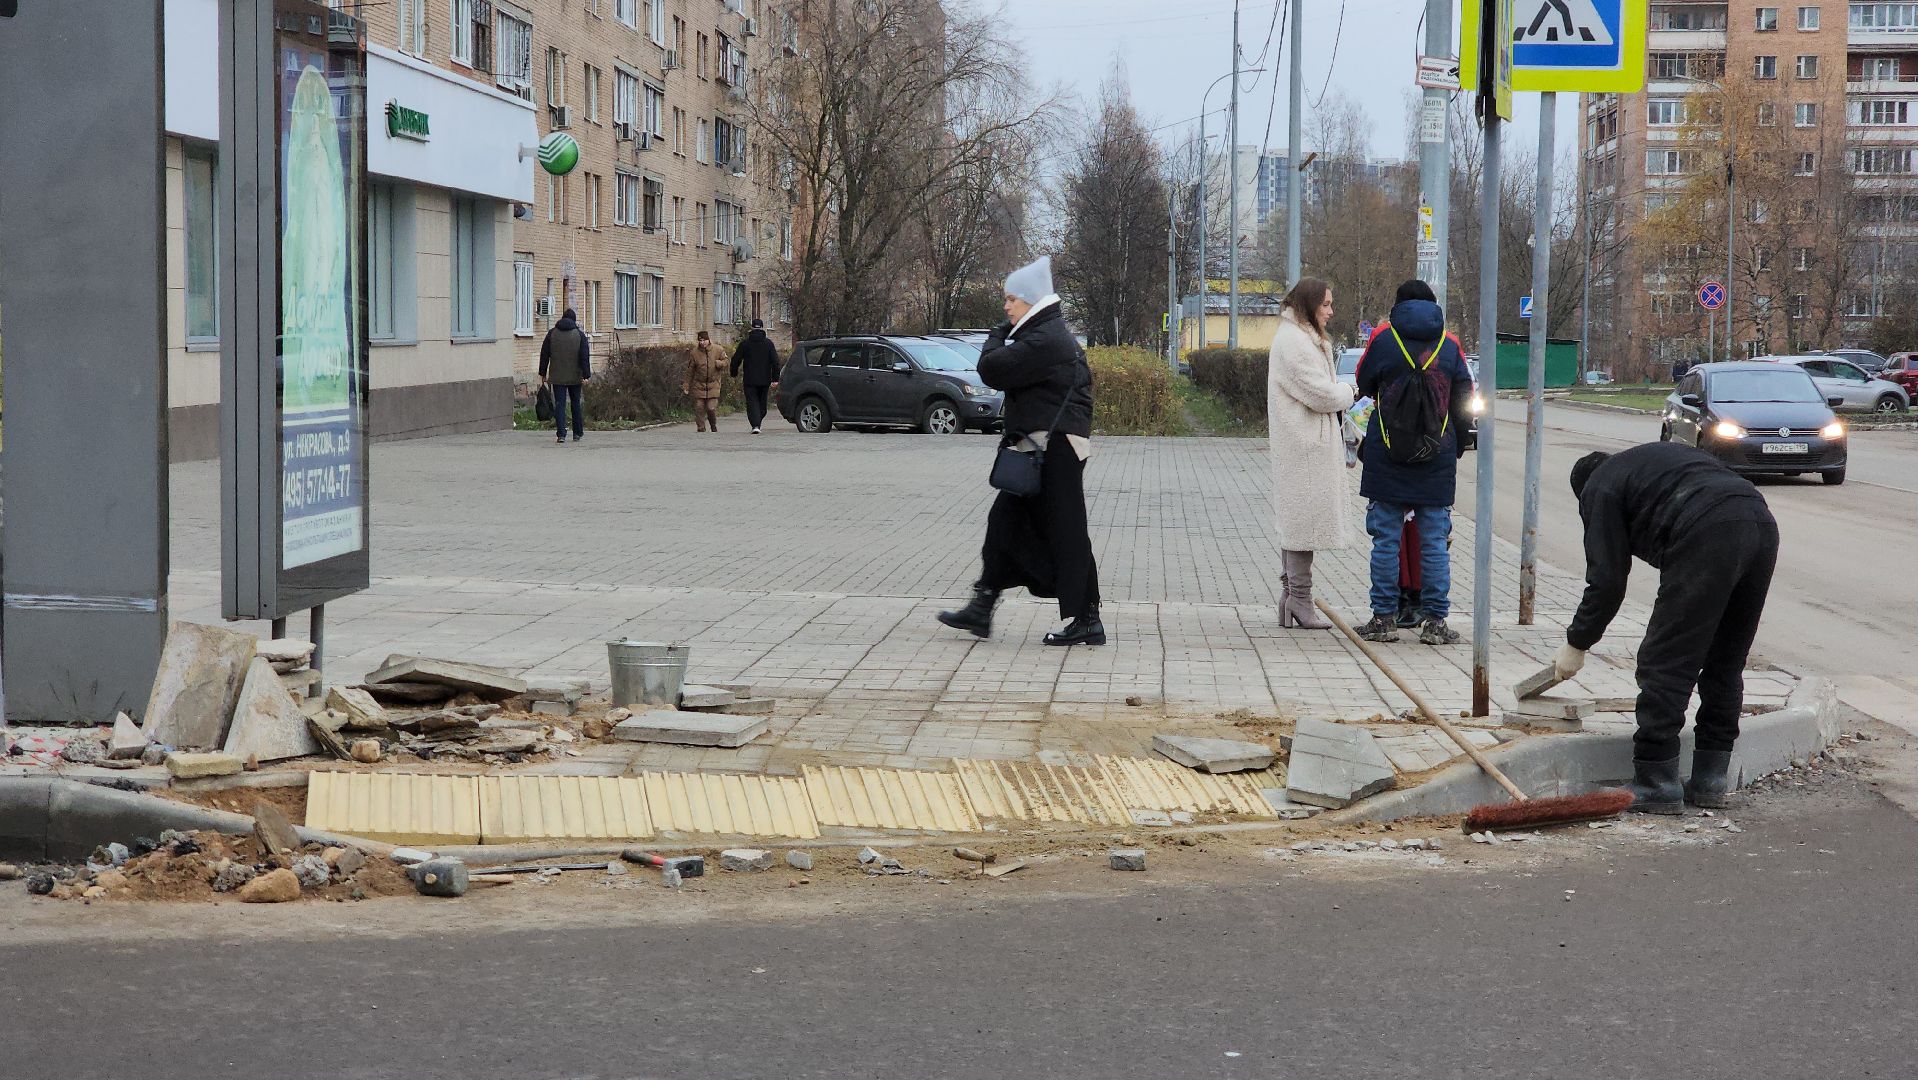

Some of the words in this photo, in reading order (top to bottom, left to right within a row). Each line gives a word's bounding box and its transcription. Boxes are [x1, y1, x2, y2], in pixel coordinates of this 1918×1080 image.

[296, 430, 336, 458] НЕКРАСОВА,
[282, 467, 305, 514] (495)
[307, 463, 351, 505] 577-14-77
